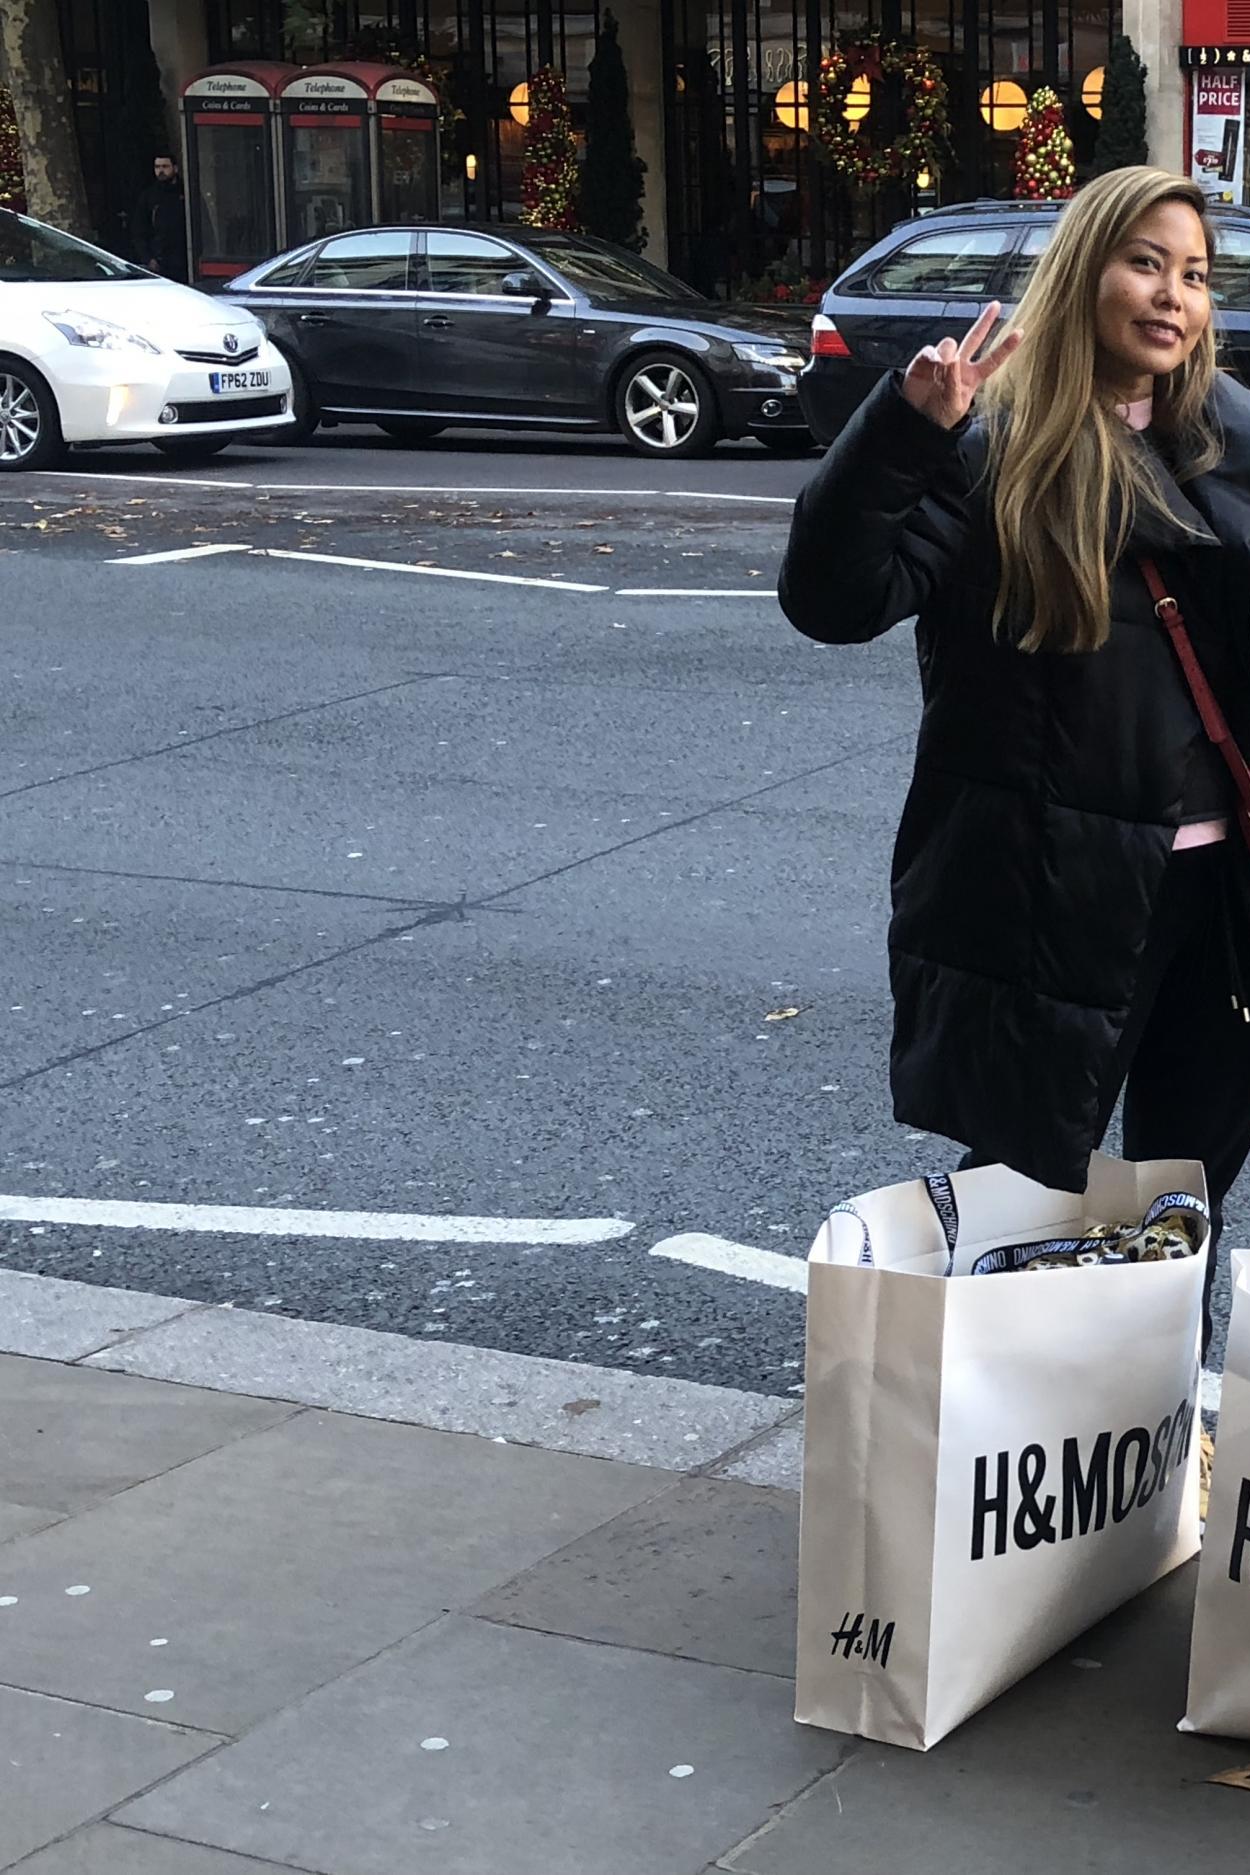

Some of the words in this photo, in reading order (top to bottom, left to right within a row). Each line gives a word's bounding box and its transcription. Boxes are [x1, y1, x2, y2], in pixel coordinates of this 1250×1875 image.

[206, 81, 247, 94] Telephone
[1201, 74, 1239, 89] HALF
[304, 82, 346, 96] Telephone
[202, 100, 221, 110] Coins
[230, 101, 251, 110] Cards
[1199, 92, 1240, 106] PRICE
[299, 102, 317, 112] Coins
[328, 103, 349, 112] Cards
[221, 372, 247, 389] FP62
[250, 371, 269, 387] ZDU
[830, 1611, 896, 1670] H&M
